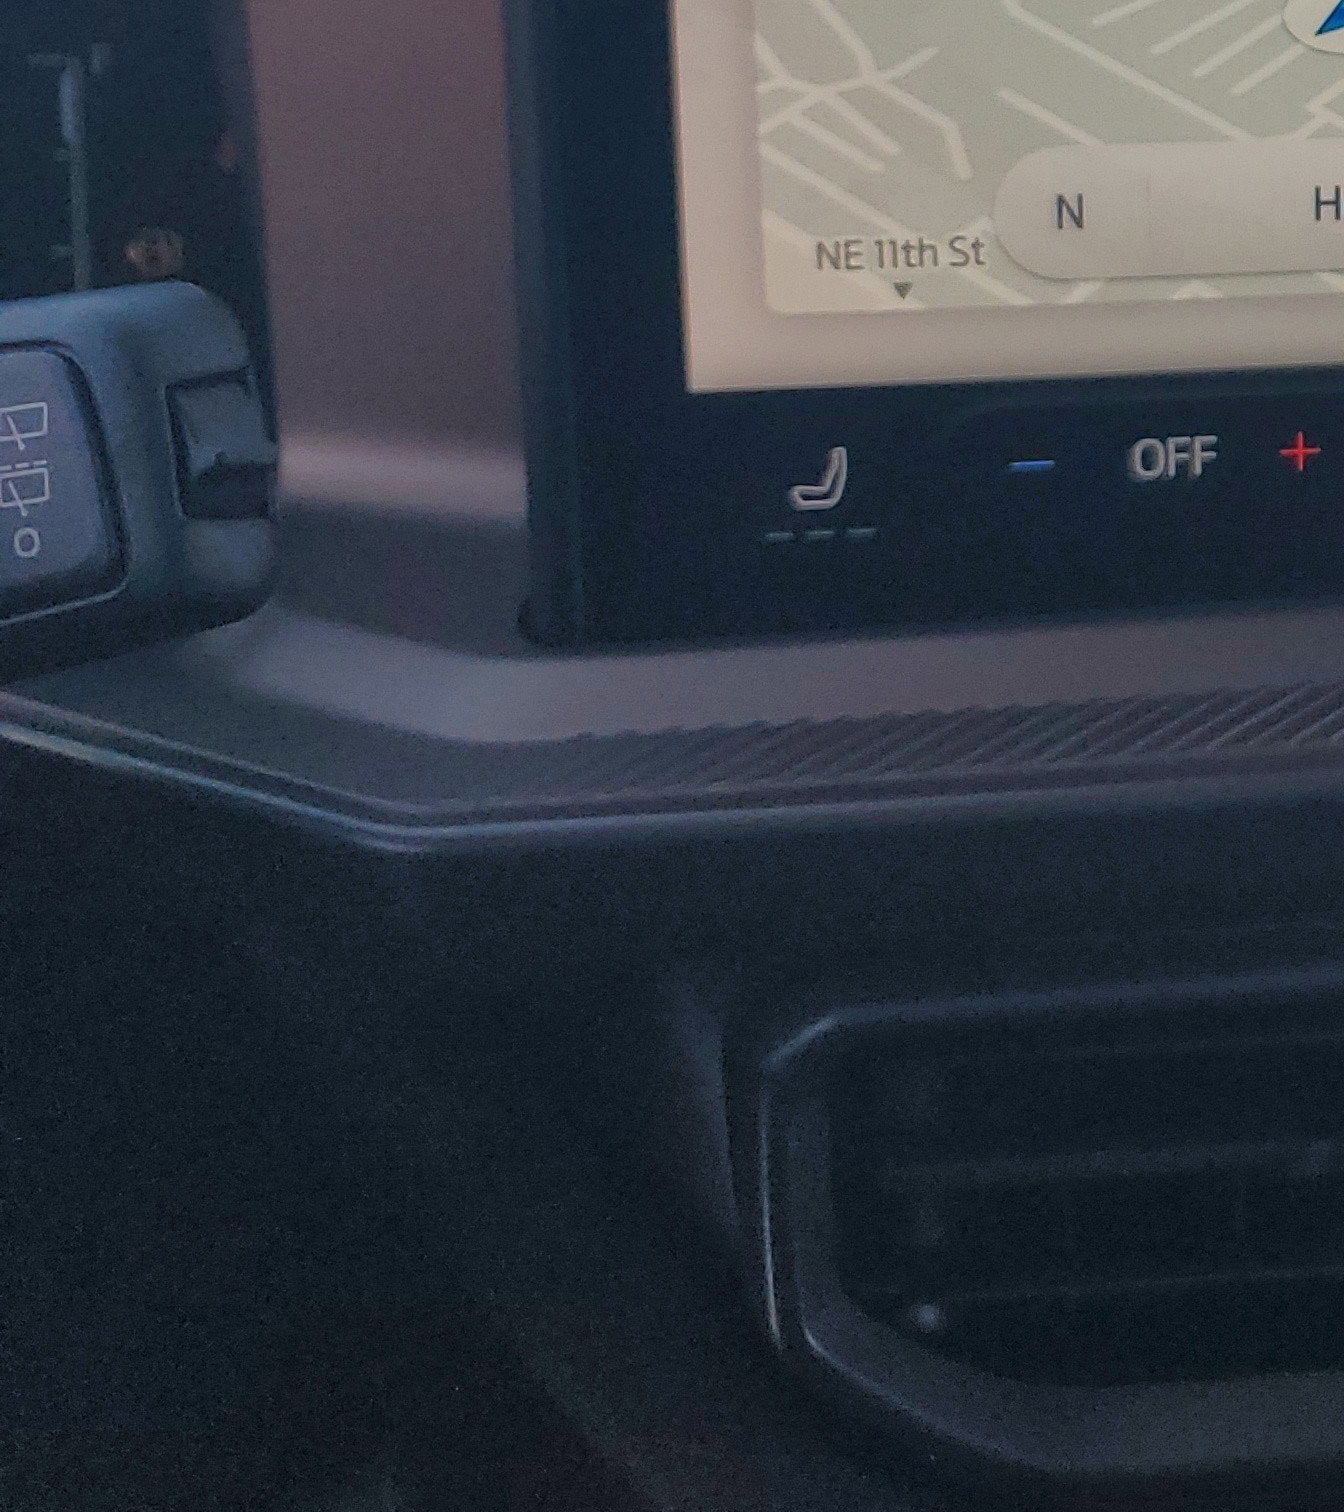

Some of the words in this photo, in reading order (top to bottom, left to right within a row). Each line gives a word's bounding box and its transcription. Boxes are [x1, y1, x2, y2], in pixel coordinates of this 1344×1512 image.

[1055, 193, 1086, 229] N
[814, 239, 864, 271] NE
[873, 238, 940, 271] 11th
[947, 236, 986, 268] St
[1127, 435, 1219, 482] OFF
